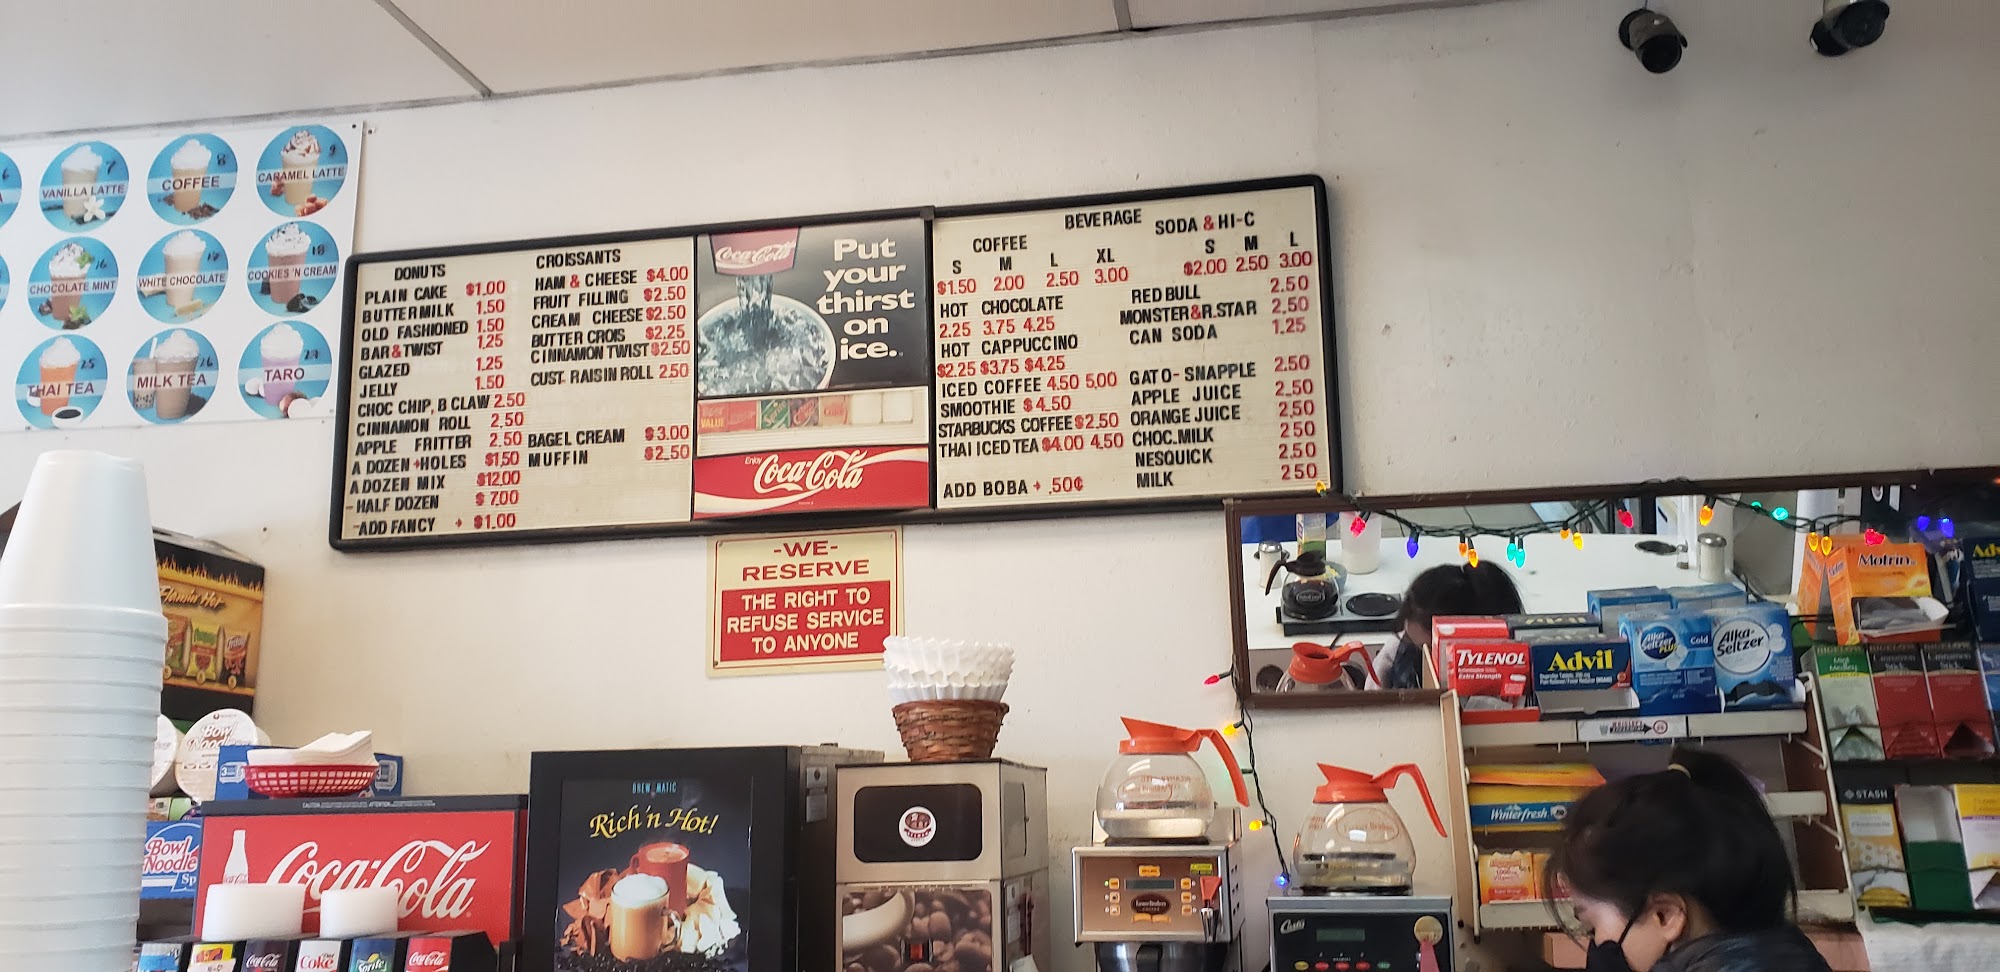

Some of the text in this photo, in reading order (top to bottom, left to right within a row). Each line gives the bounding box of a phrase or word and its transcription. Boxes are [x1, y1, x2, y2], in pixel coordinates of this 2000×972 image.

[162, 175, 220, 192] COFFEE
[258, 166, 344, 183] CARAMEL LATTE
[42, 183, 125, 199] VANILLA LATTE
[1065, 208, 1141, 230] BEVERAGE
[1155, 211, 1254, 235] SODA & HI-C
[834, 237, 896, 261] Put
[973, 235, 1027, 253] COFFEE
[1205, 232, 1298, 254] S M L
[536, 249, 620, 269] CROISSANTS
[715, 241, 797, 269] Coca-Cola
[953, 248, 1115, 274] S M L XL
[248, 269, 290, 281] COOKIES
[304, 265, 337, 277] CREAM
[395, 264, 445, 281] DONUTS
[1184, 255, 1268, 276] $2.00 2.50
[30, 280, 116, 294] CHOCOLATE MINT
[138, 272, 225, 288] WHITE CHOCOLATE
[535, 266, 688, 291] HAM & CHEESE $4.00
[823, 264, 906, 292] your
[938, 266, 1128, 295] $1.50 2.00 2.50 3.00
[365, 285, 447, 305] PLAIN CAKE
[534, 289, 628, 310] FRUIT FILLING
[1132, 276, 1308, 304] RED BULL 2.50
[816, 289, 915, 314] thirst
[941, 295, 1063, 318] HOT CHOCOLATE
[363, 303, 454, 323] BUTTERMILK
[532, 308, 643, 329] CREAM CHEESE
[362, 321, 468, 341] OLD FASHIONED
[844, 317, 889, 335] on
[984, 316, 1055, 335] 3.75 4.25
[1130, 324, 1217, 345] CAN SODA
[531, 324, 685, 348] BUTTER CROIS $2.25
[942, 334, 1078, 358] HOT CAPPUCCINO
[531, 343, 649, 364] CINNAMON TWIST
[840, 338, 897, 360] ice.
[264, 368, 305, 382] TARO
[359, 363, 410, 379] GLAZED
[570, 367, 617, 384] RAISIN
[620, 365, 654, 381] ROLL
[938, 361, 976, 378] $2.25
[1185, 361, 1256, 381] SNAPPLE
[28, 382, 94, 398] THAI TEA
[137, 372, 207, 389] MILK TEA
[360, 382, 397, 398] JELLY
[942, 377, 1041, 398] ICED COFFEE
[1132, 384, 1241, 406] APPLE JUICE
[358, 402, 393, 417] CHOC
[438, 398, 447, 412] B
[451, 395, 490, 411] CLAW
[941, 399, 1015, 418] SMOOTHIE
[1131, 405, 1240, 426] ORANGE JUICE
[357, 416, 471, 436] CINNAMON ROLL
[939, 415, 1073, 438] STARBUCKS COFFEE
[355, 434, 471, 456] APPLE FRITTER
[528, 428, 625, 448] BAGEL CREAM
[939, 438, 1039, 458] THAI ICED TEA
[352, 458, 409, 475] A DOZEN
[529, 450, 588, 467] MUFFIN
[745, 457, 762, 465] Enjoy
[1136, 448, 1213, 467] NESQUICK
[754, 450, 868, 493] Coca-Cola
[1137, 471, 1173, 488] MILK
[350, 475, 445, 494] A DOZEN MIX
[944, 479, 1028, 498] ADD BOBA
[395, 495, 439, 511] DOZEN
[391, 517, 435, 533] FANCY
[743, 560, 869, 581] RESERVE
[1859, 554, 1910, 567] Motrin
[742, 587, 870, 611] THE RIGHT TO
[727, 608, 884, 633] REFUSE SERVICE
[752, 632, 858, 653] TO ANYONE
[1690, 635, 1709, 645] Cold
[1717, 636, 1764, 657] Seltzer
[1456, 649, 1526, 666] TYLENOL
[1547, 649, 1614, 671] Advil
[1856, 789, 1888, 799] STASH
[589, 804, 642, 839] Rich
[664, 807, 719, 835] Hot!
[1490, 808, 1548, 822] Winterfresh
[147, 836, 192, 855] Bowl
[142, 855, 198, 873] Noodle
